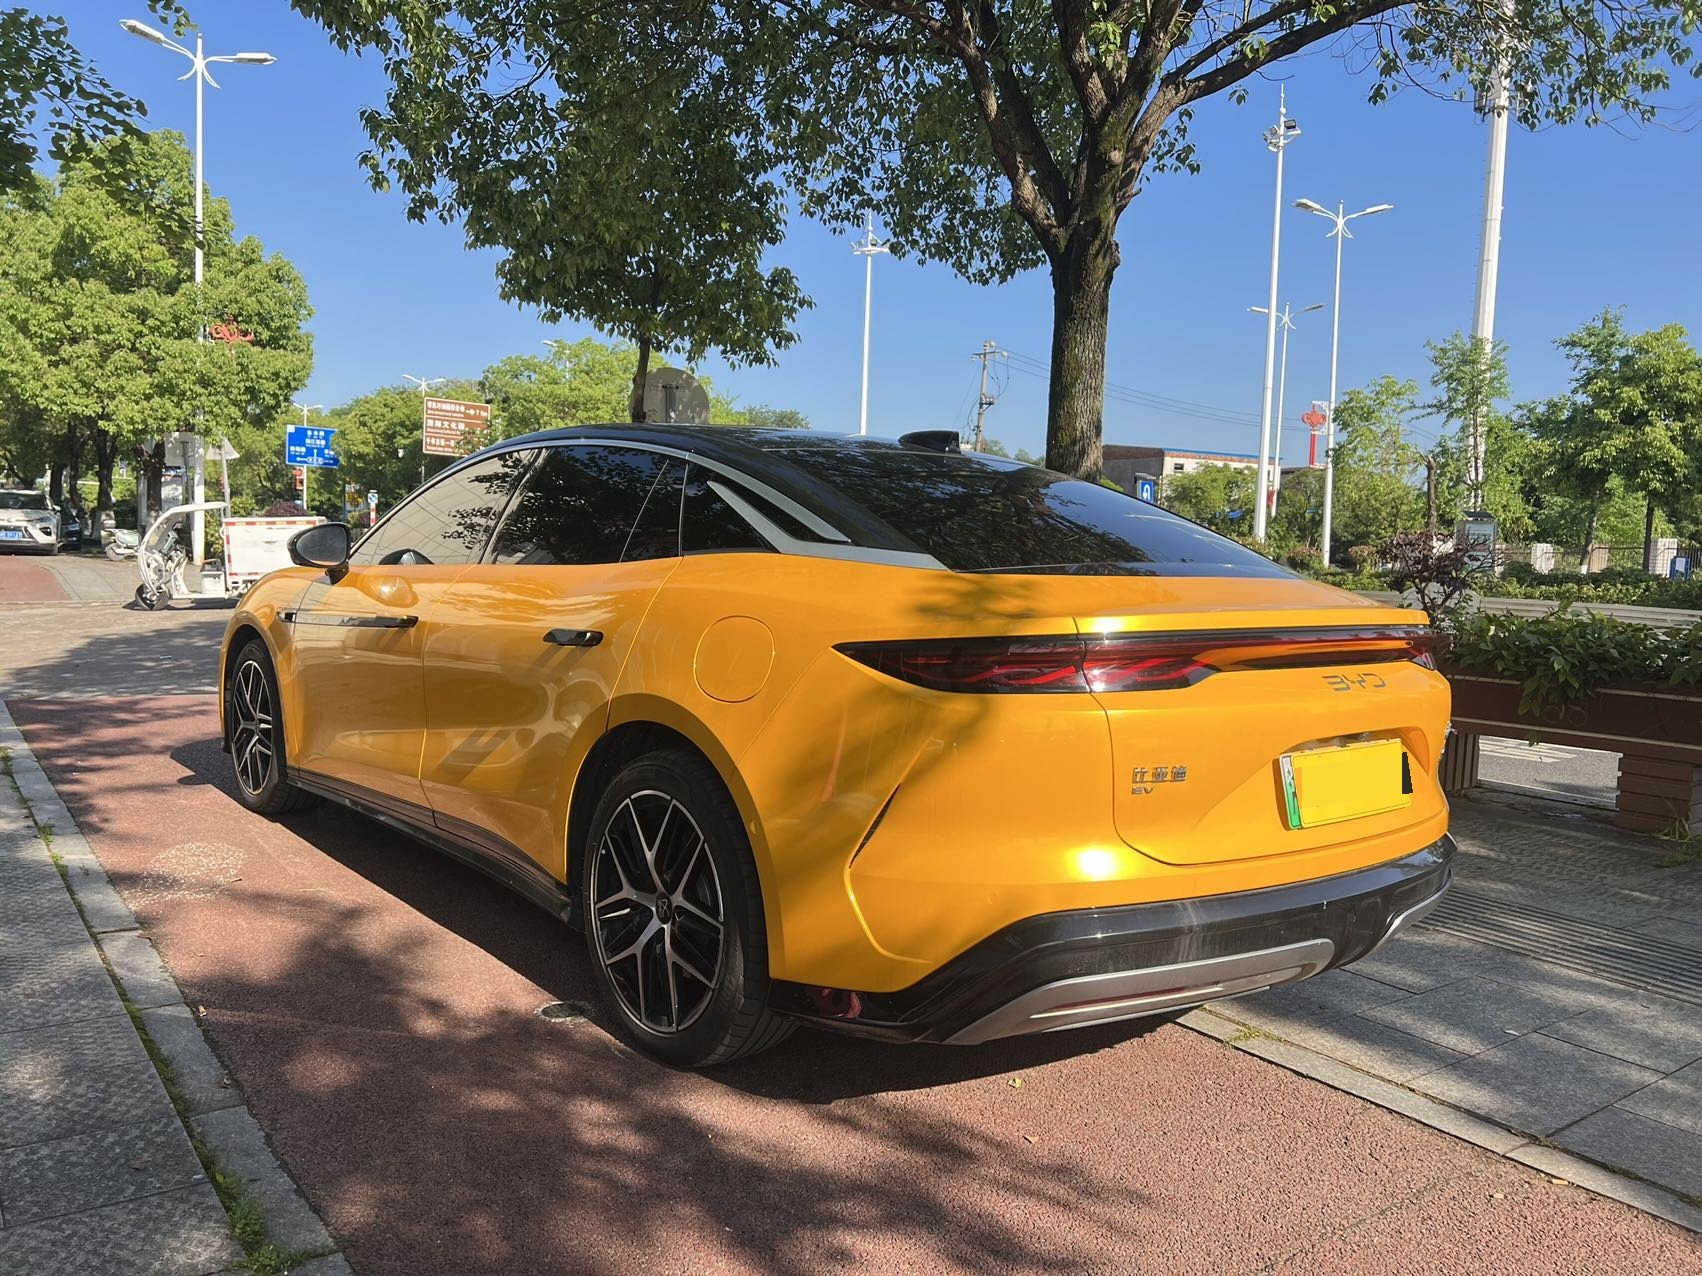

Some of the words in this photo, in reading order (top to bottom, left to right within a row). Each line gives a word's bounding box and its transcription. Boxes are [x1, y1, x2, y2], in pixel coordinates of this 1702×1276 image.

[1322, 673, 1386, 692] BYD
[1132, 765, 1187, 784] 比亚迪
[1131, 786, 1153, 796] EV
